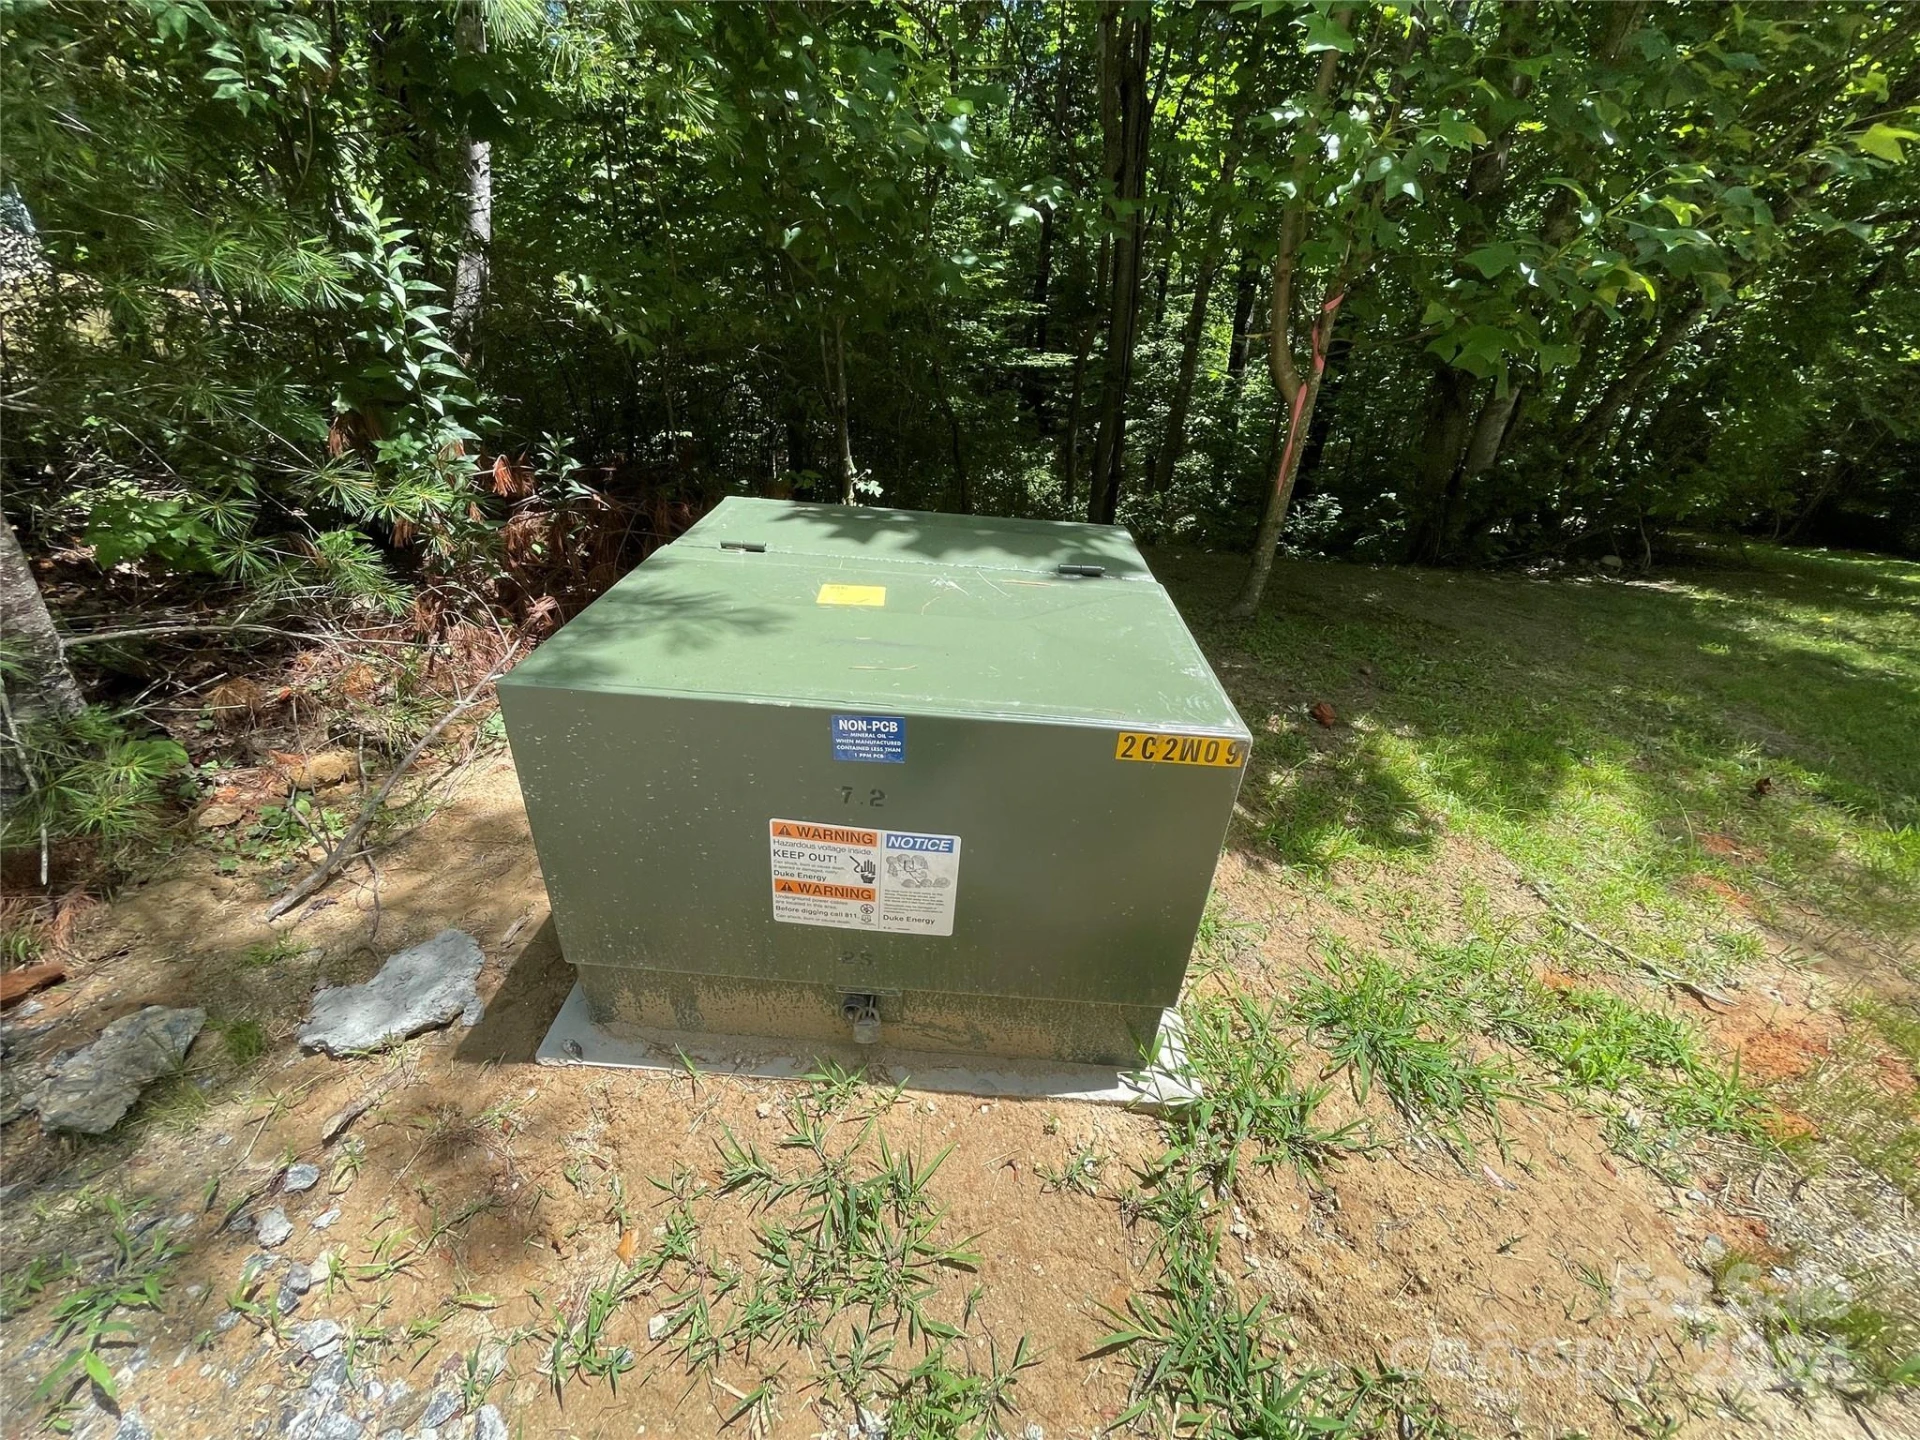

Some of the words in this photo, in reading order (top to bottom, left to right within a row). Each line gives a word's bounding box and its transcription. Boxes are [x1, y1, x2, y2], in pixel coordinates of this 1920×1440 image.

[838, 720, 898, 732] NON-PCB
[842, 786, 886, 807] 7.2
[796, 826, 873, 844] WARNING
[773, 839, 816, 850] Hazardous
[818, 844, 846, 854] voltage
[848, 847, 874, 856] inside.
[888, 836, 951, 851] NOTICE
[773, 849, 805, 860] KEEP
[809, 853, 837, 863] OUT!
[798, 872, 827, 881] Energy
[798, 883, 872, 900] WARNING
[801, 908, 828, 917] digging
[883, 914, 904, 922] Duke
[906, 917, 935, 925] Energy
